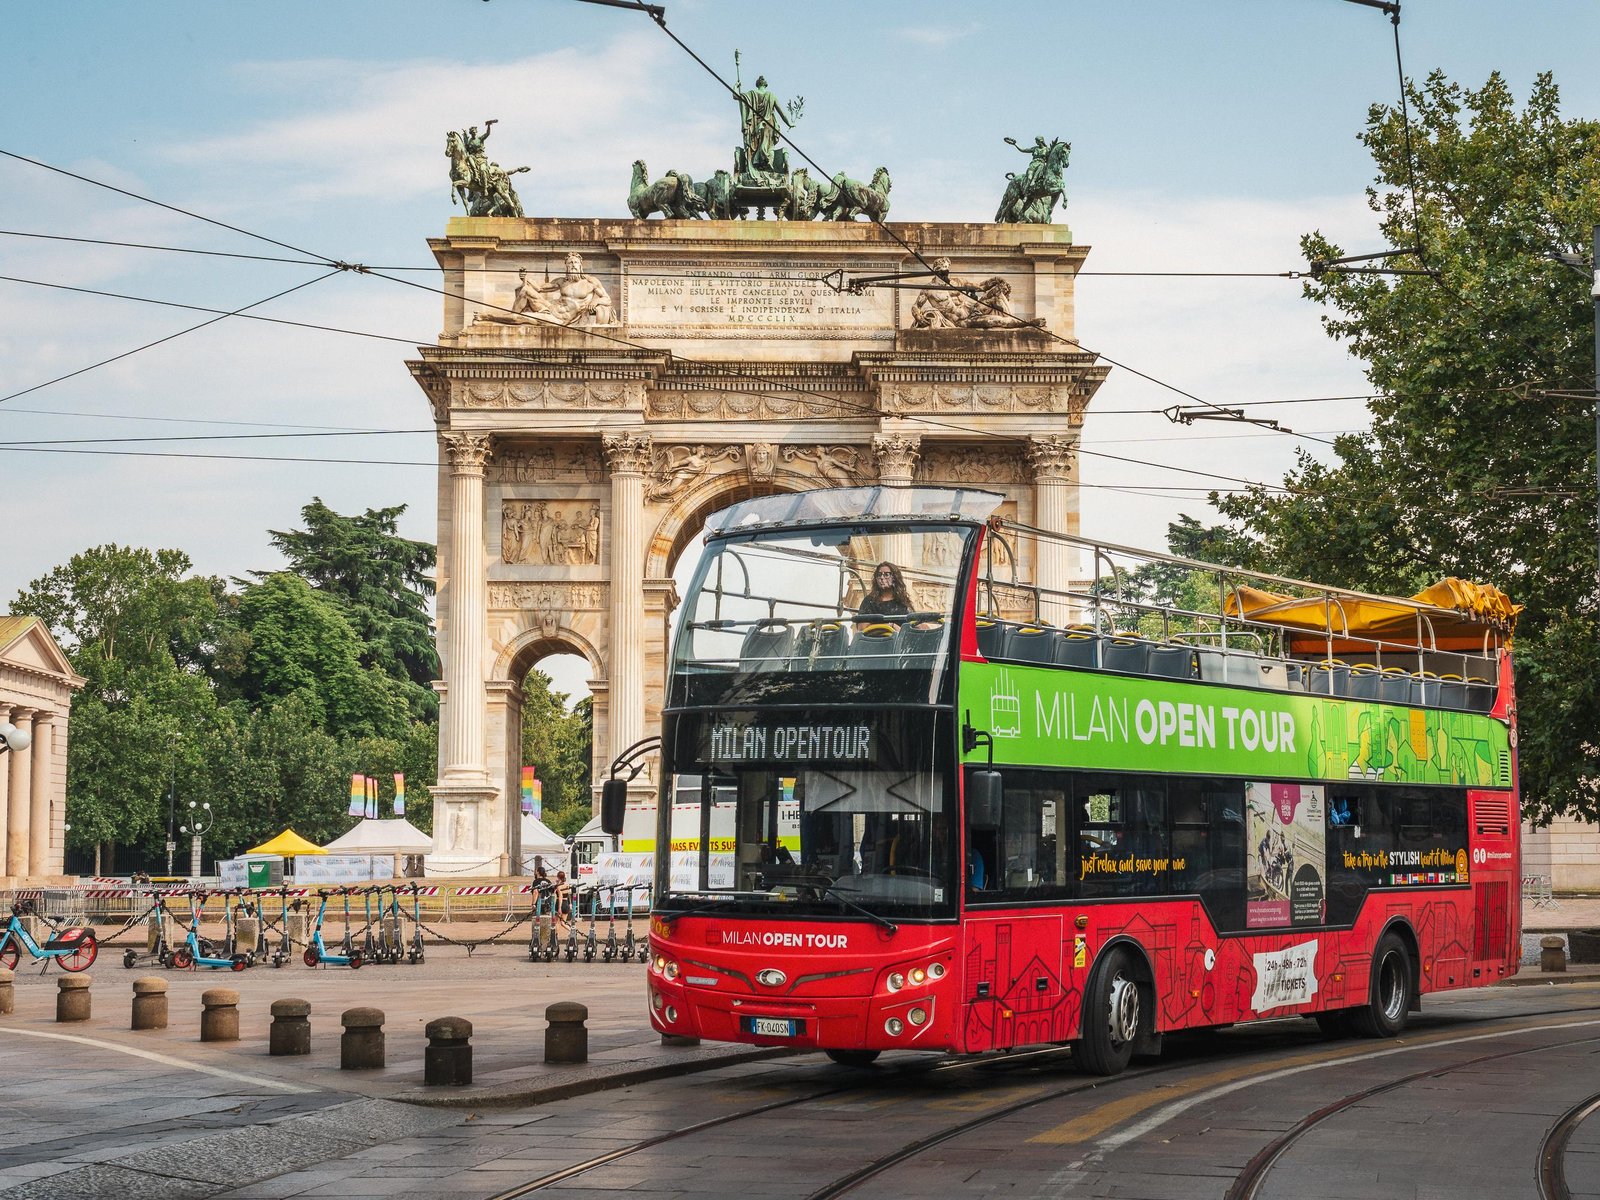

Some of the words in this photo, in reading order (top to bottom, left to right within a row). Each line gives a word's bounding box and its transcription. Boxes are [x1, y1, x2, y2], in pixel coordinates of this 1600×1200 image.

[632, 279, 685, 287] NAPOLEONE
[769, 280, 817, 288] EMANUELE
[689, 288, 737, 296] ESULTANTE
[793, 289, 805, 297] DA
[727, 297, 773, 305] IMPRONTE
[742, 306, 811, 314] INDIPENDENZA
[1035, 689, 1128, 743] MILAN
[1135, 698, 1216, 749] OPEN
[1222, 705, 1296, 753] TOUR
[711, 727, 767, 759] MILAN
[773, 726, 870, 759] OPENTOUR
[1389, 851, 1420, 865] STYLISH
[1080, 852, 1099, 881] just
[1097, 853, 1117, 873] relax
[1119, 853, 1134, 873] and
[1135, 858, 1153, 872] save
[1153, 858, 1169, 876] your
[722, 930, 761, 945] MILAN
[762, 932, 803, 947] OPEN
[805, 933, 848, 949] TOUR
[1267, 960, 1278, 971] 24h
[1296, 957, 1307, 968] 72h
[1281, 977, 1306, 991] TICKETS
